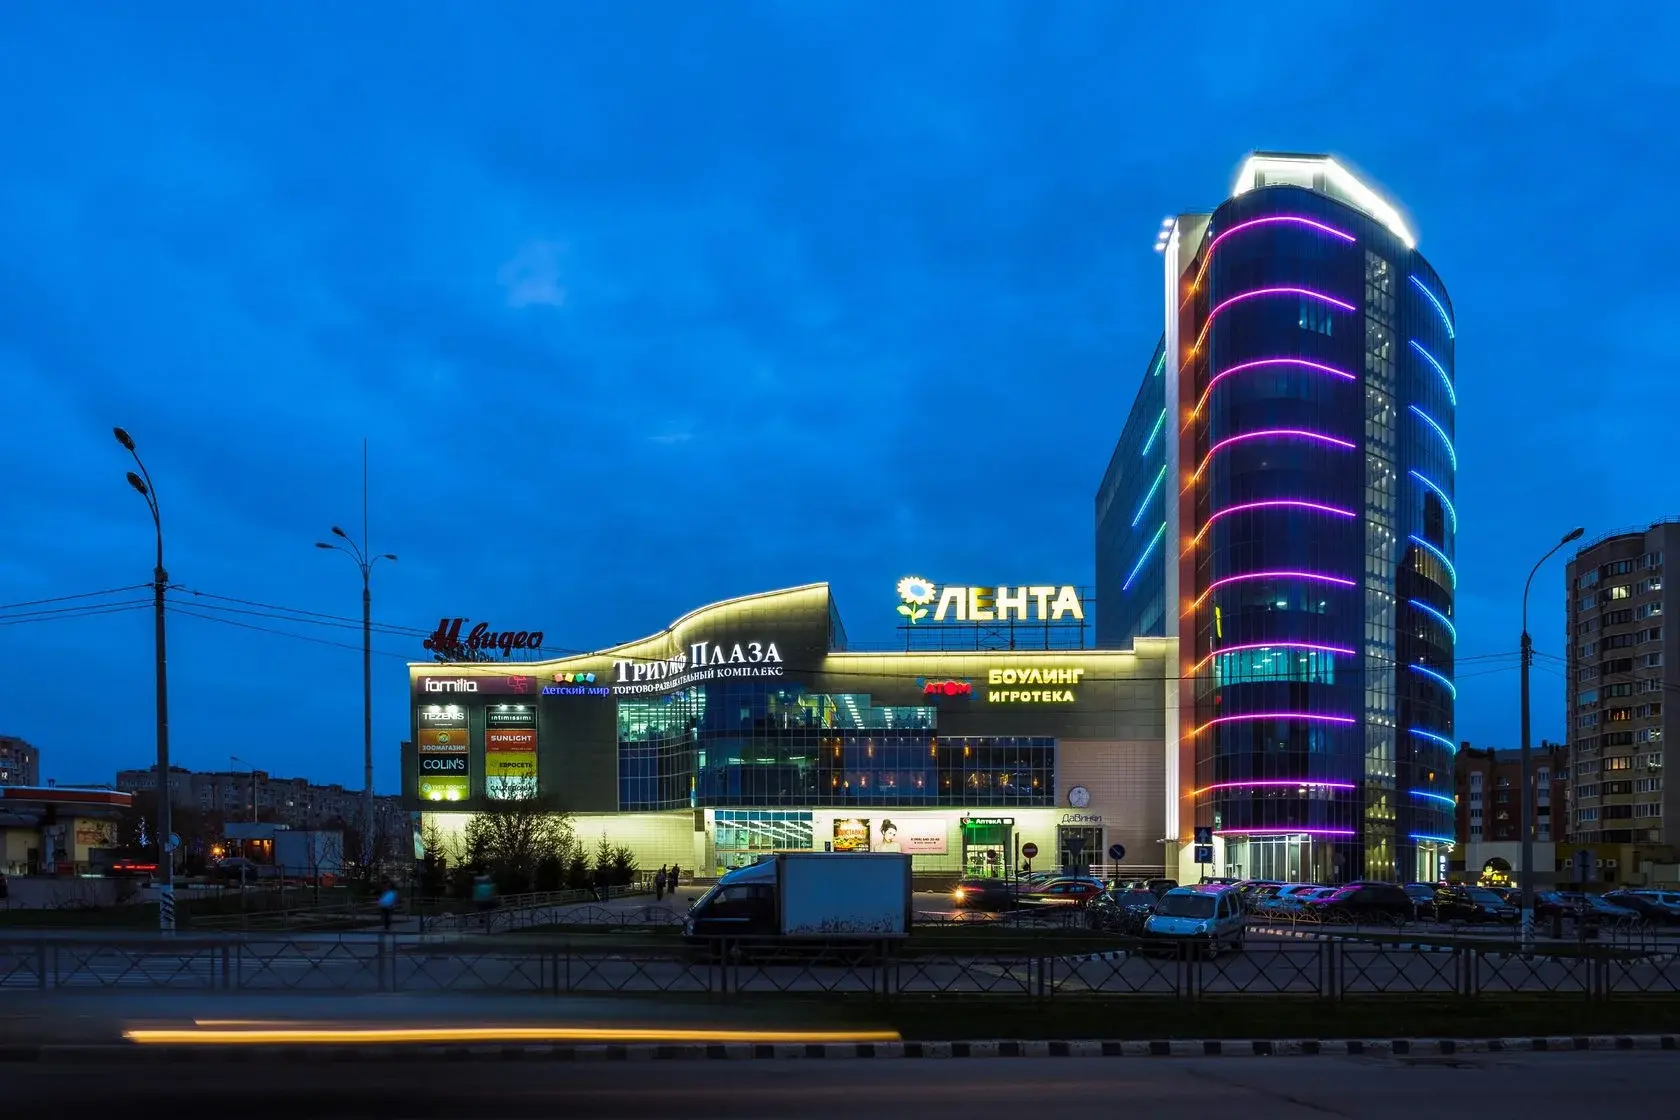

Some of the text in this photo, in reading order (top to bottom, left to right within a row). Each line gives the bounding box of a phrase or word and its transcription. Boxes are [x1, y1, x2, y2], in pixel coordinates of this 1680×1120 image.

[934, 586, 1084, 620] ЛЕНТА
[690, 641, 783, 669] ПЛАЗА
[717, 666, 783, 677] КОМПЛЕКС
[988, 668, 1085, 685] БОУЛИНГ
[425, 678, 477, 692] familia
[541, 685, 610, 697] Детский мир
[988, 691, 1075, 702] ИГРОТЕКА
[422, 712, 464, 720] TEZENIS
[423, 758, 465, 770] COLIN'S
[1198, 847, 1209, 859] P
